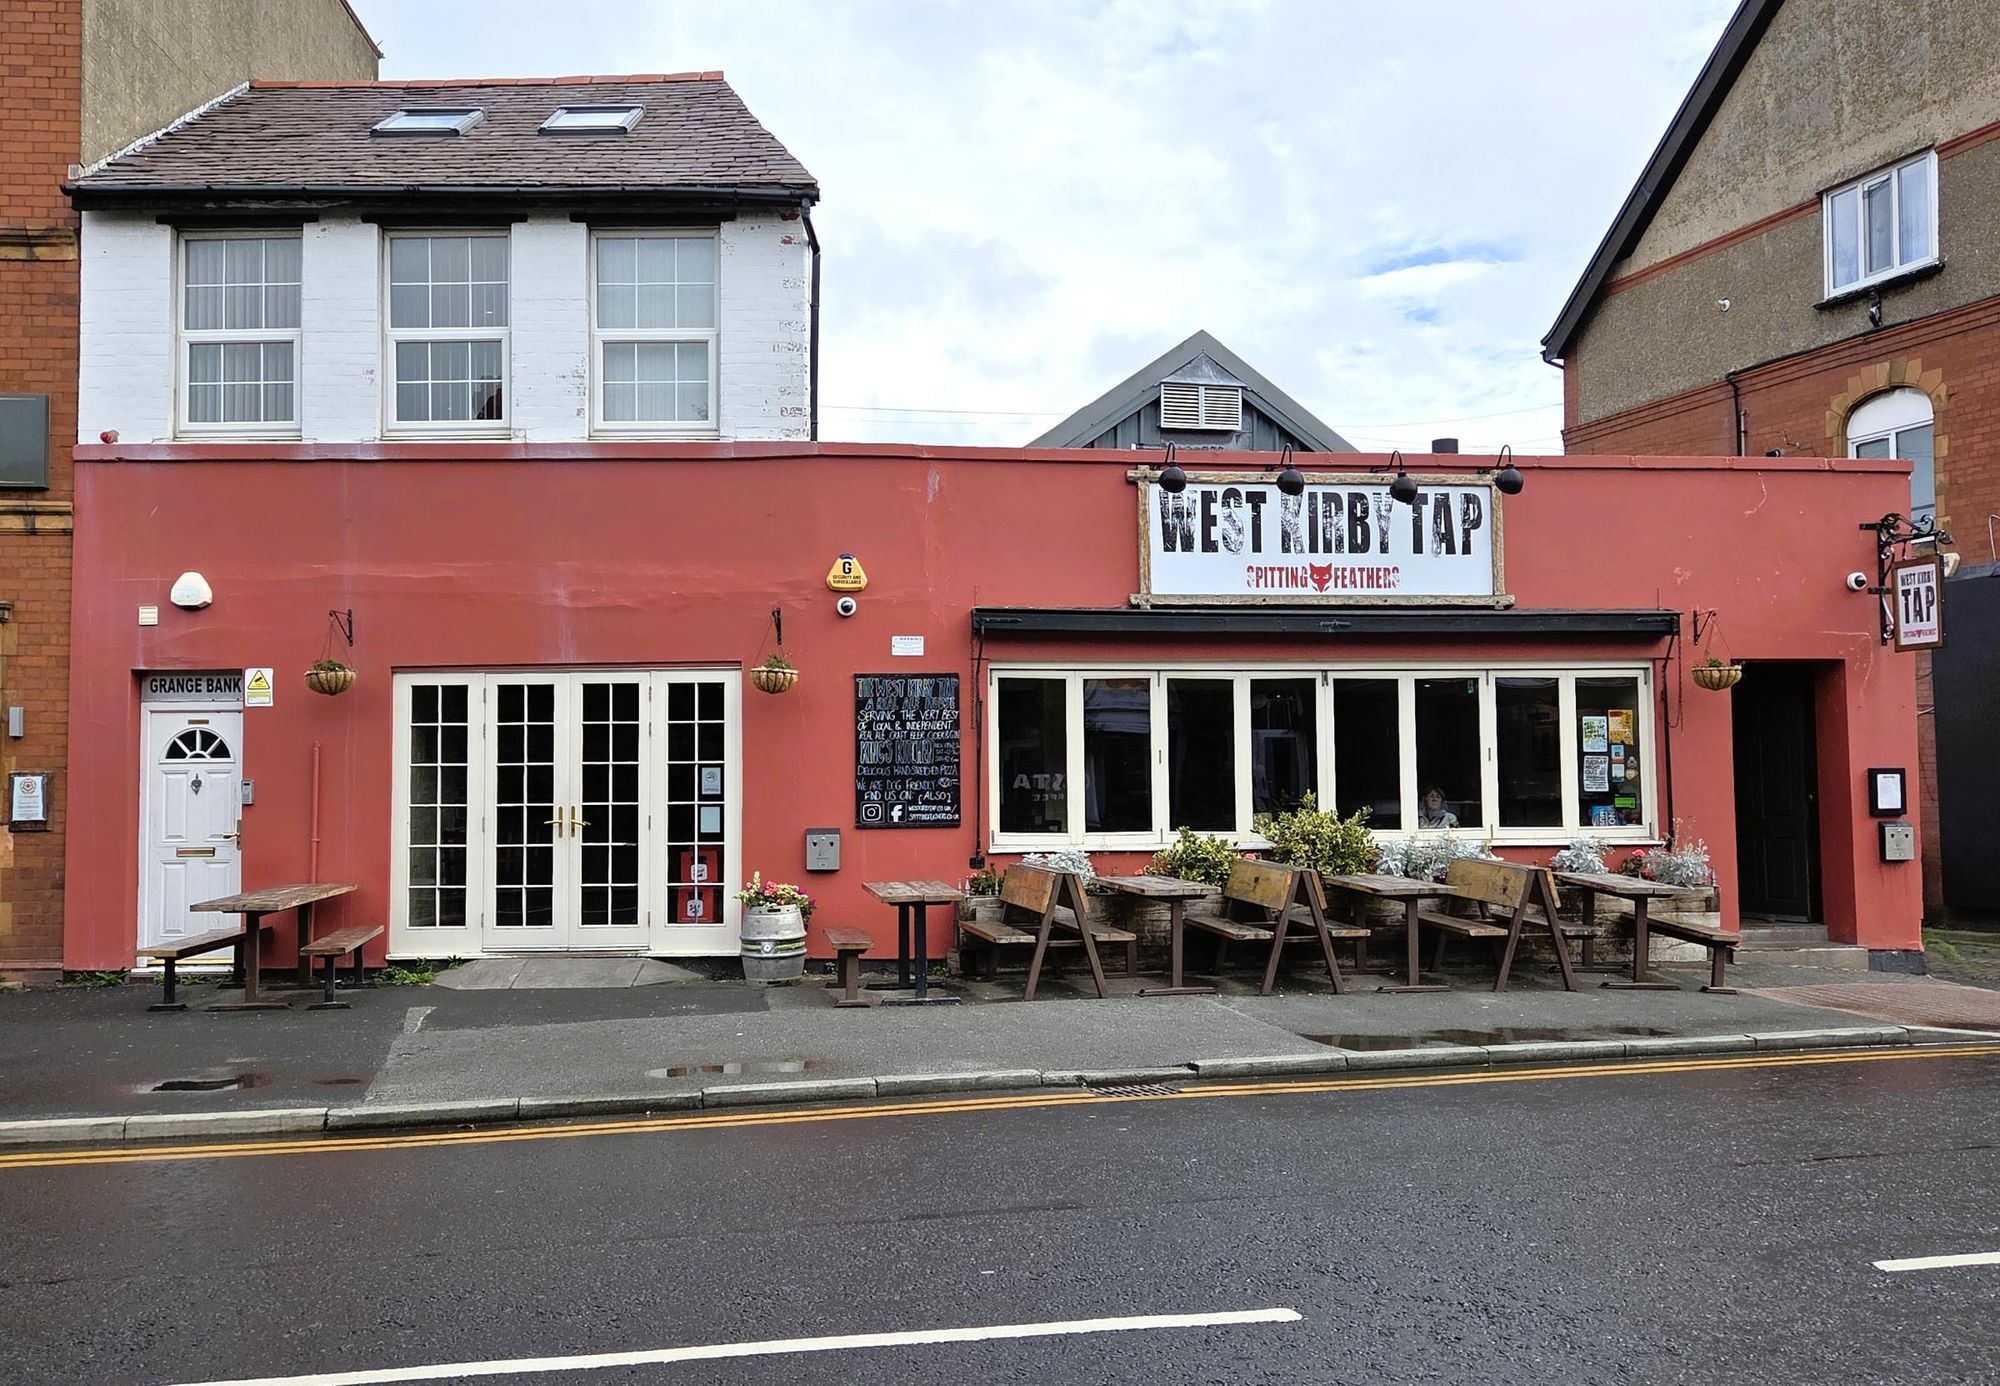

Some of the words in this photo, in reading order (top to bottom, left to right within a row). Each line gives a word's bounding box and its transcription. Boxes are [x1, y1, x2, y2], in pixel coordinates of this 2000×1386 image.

[1159, 487, 1267, 556] WEST
[1281, 490, 1395, 556] KIRBY
[1410, 491, 1484, 557] TAP
[842, 561, 852, 575] G
[1246, 565, 1309, 589] SPITTING
[1333, 566, 1401, 590] FEATHERS
[1901, 573, 1915, 586] WEST
[1917, 570, 1934, 584] KIRBY
[1901, 586, 1935, 624] TAP
[150, 677, 203, 693] GRANGE
[206, 677, 242, 693] BANK
[875, 678, 906, 698] WEST
[857, 709, 896, 722] SERVING
[900, 710, 916, 721] THE
[920, 709, 940, 721] VERY
[941, 708, 959, 721] BEST
[857, 721, 868, 731] OF
[873, 721, 893, 731] LOCAL
[894, 720, 903, 731] &
[906, 720, 954, 731] INDEPENDENT
[859, 731, 873, 741] REAL
[910, 731, 926, 740] BEER
[857, 764, 891, 776] DELICIOUS
[940, 763, 958, 776] PIZZA
[856, 777, 867, 791] WE
[869, 779, 883, 790] ARE
[886, 779, 902, 791] DOG
[905, 777, 936, 791] FRIENDLY
[864, 790, 882, 801] FIND
[885, 790, 897, 801] US
[923, 790, 947, 801] ALSO
